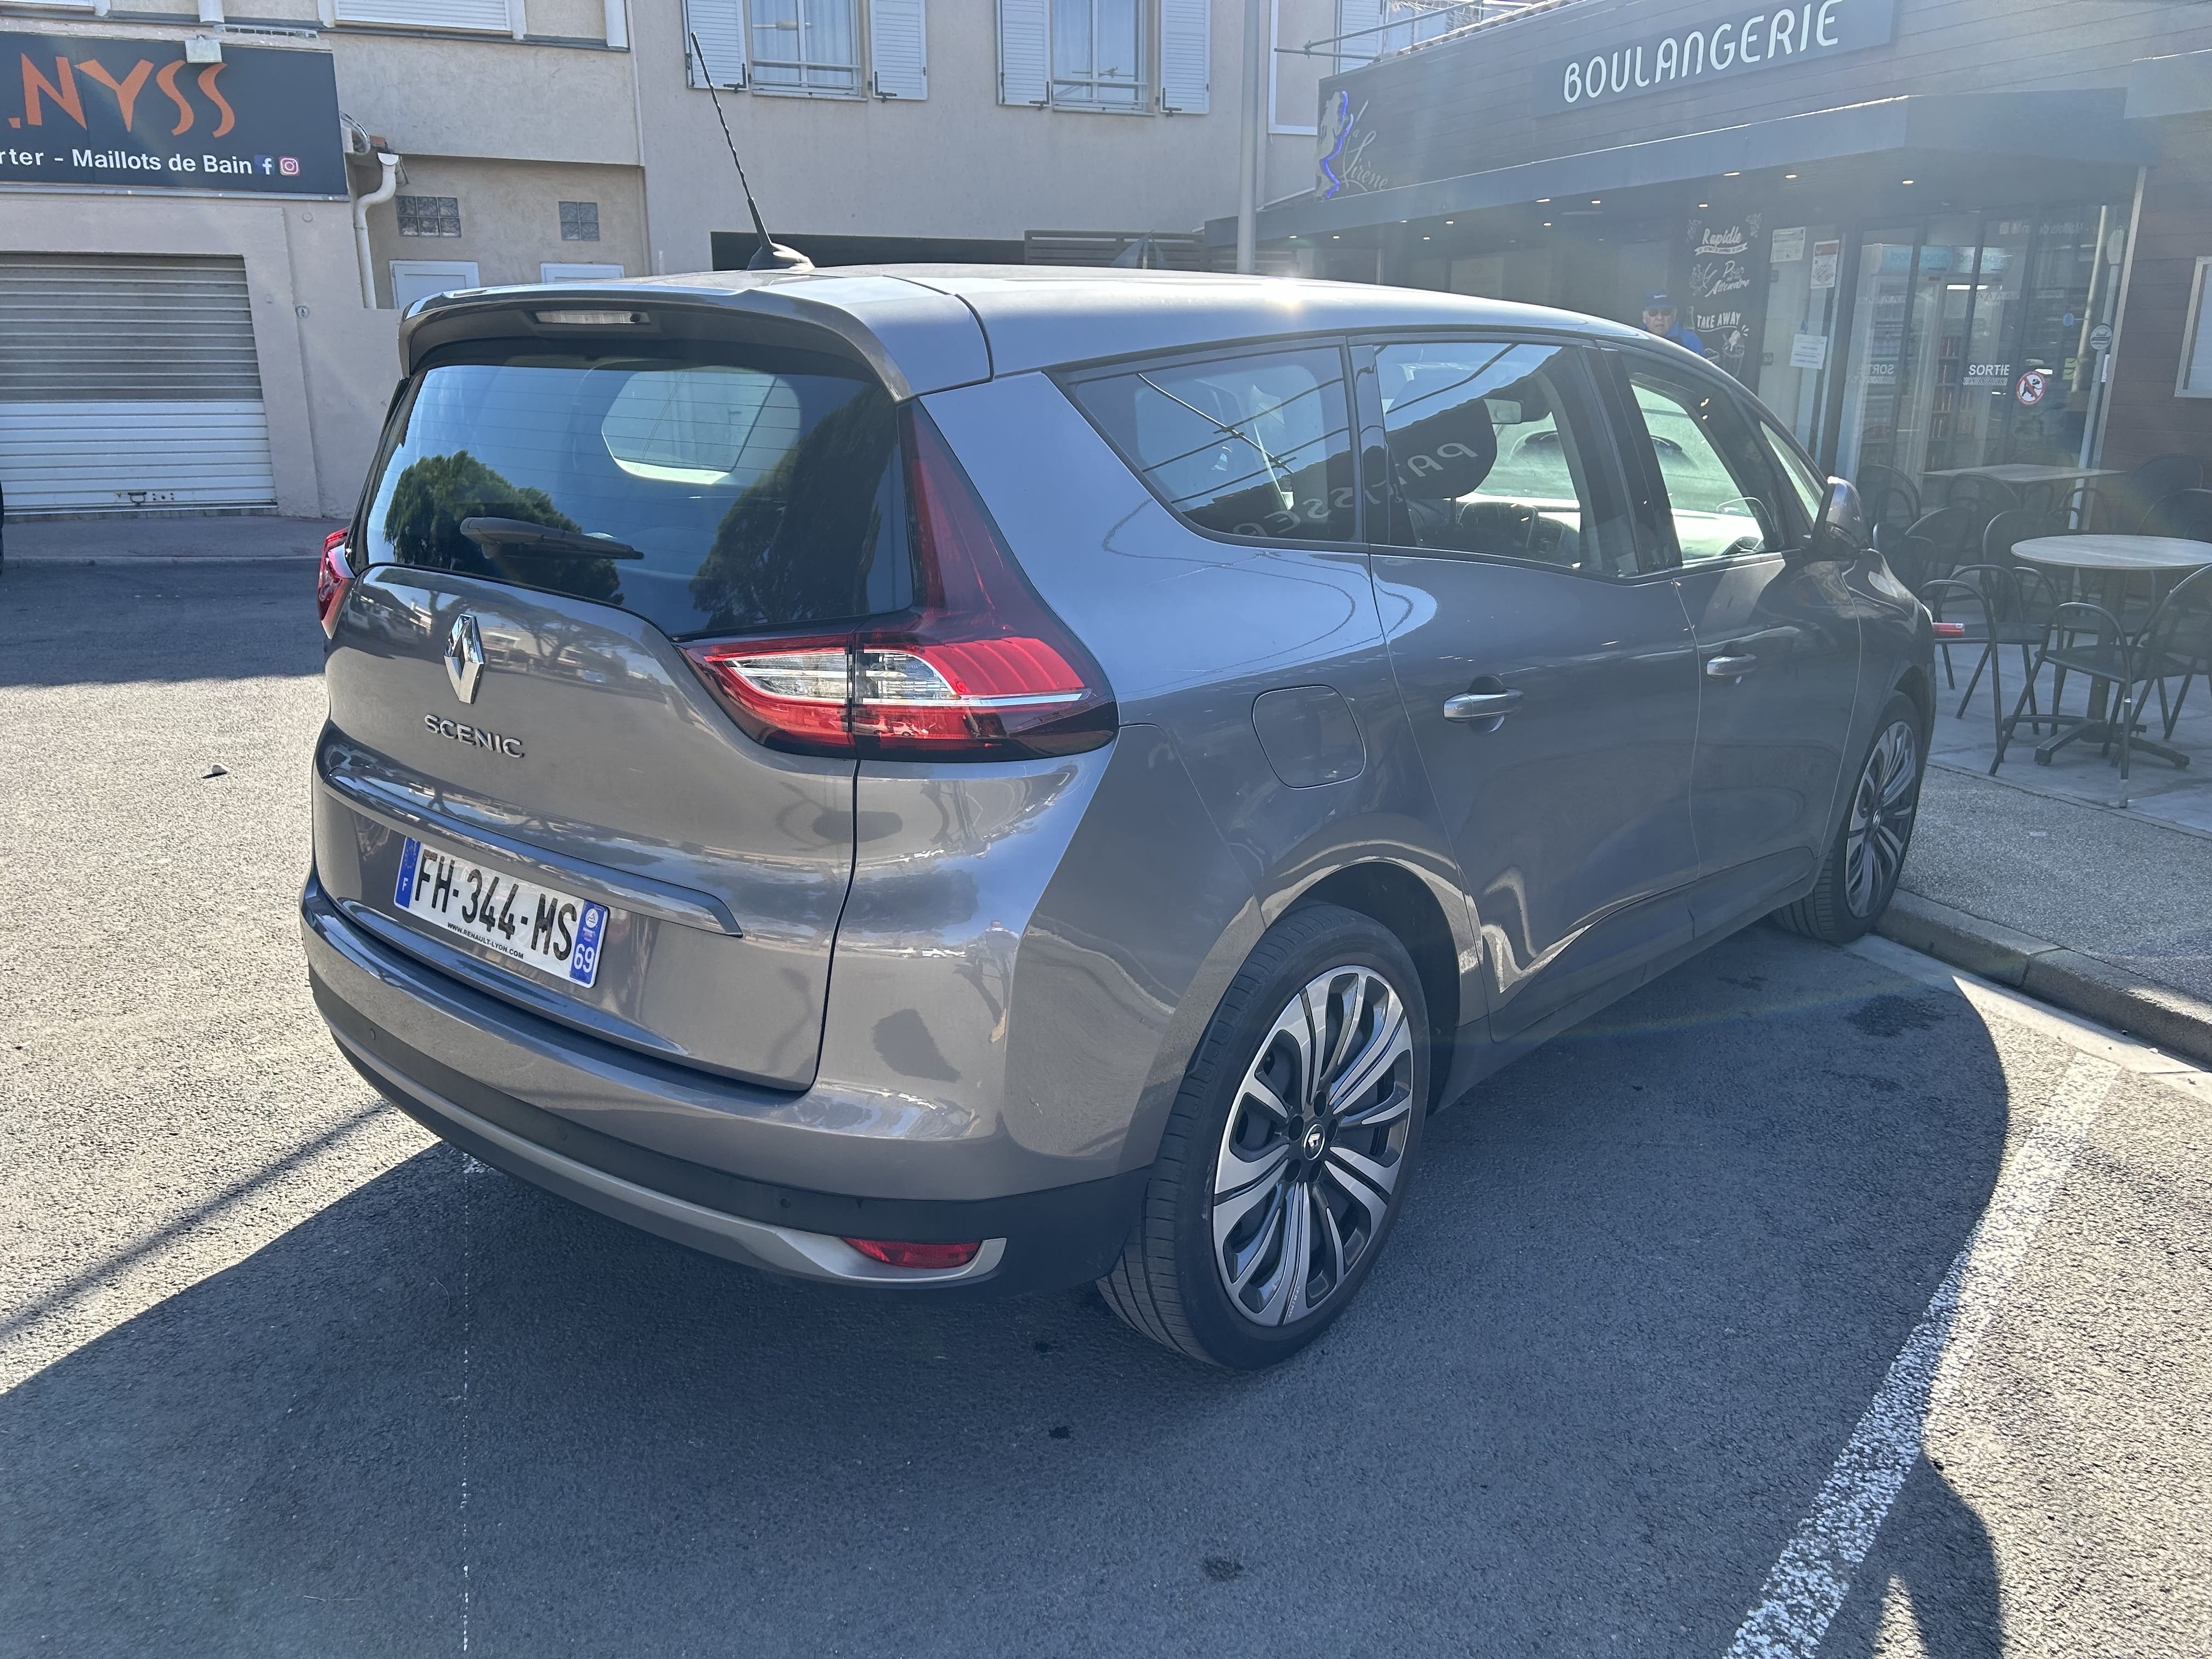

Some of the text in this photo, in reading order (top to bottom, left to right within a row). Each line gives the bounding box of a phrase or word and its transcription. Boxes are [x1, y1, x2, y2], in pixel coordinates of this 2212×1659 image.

[1564, 0, 1842, 103] BOULANGERIE
[72, 149, 162, 171] Maillots
[168, 154, 196, 172] de
[203, 155, 252, 174] Bain
[1339, 130, 1389, 191] Sirène
[1697, 312, 1741, 329] TAKE AWAY
[1968, 364, 2010, 376] SORTIE
[424, 714, 525, 759] SCENIC
[402, 877, 408, 891] F
[414, 849, 578, 961] FH-344-MS
[447, 922, 524, 960] WWW.RENAULT-LYON.COM
[574, 943, 595, 973] 69
